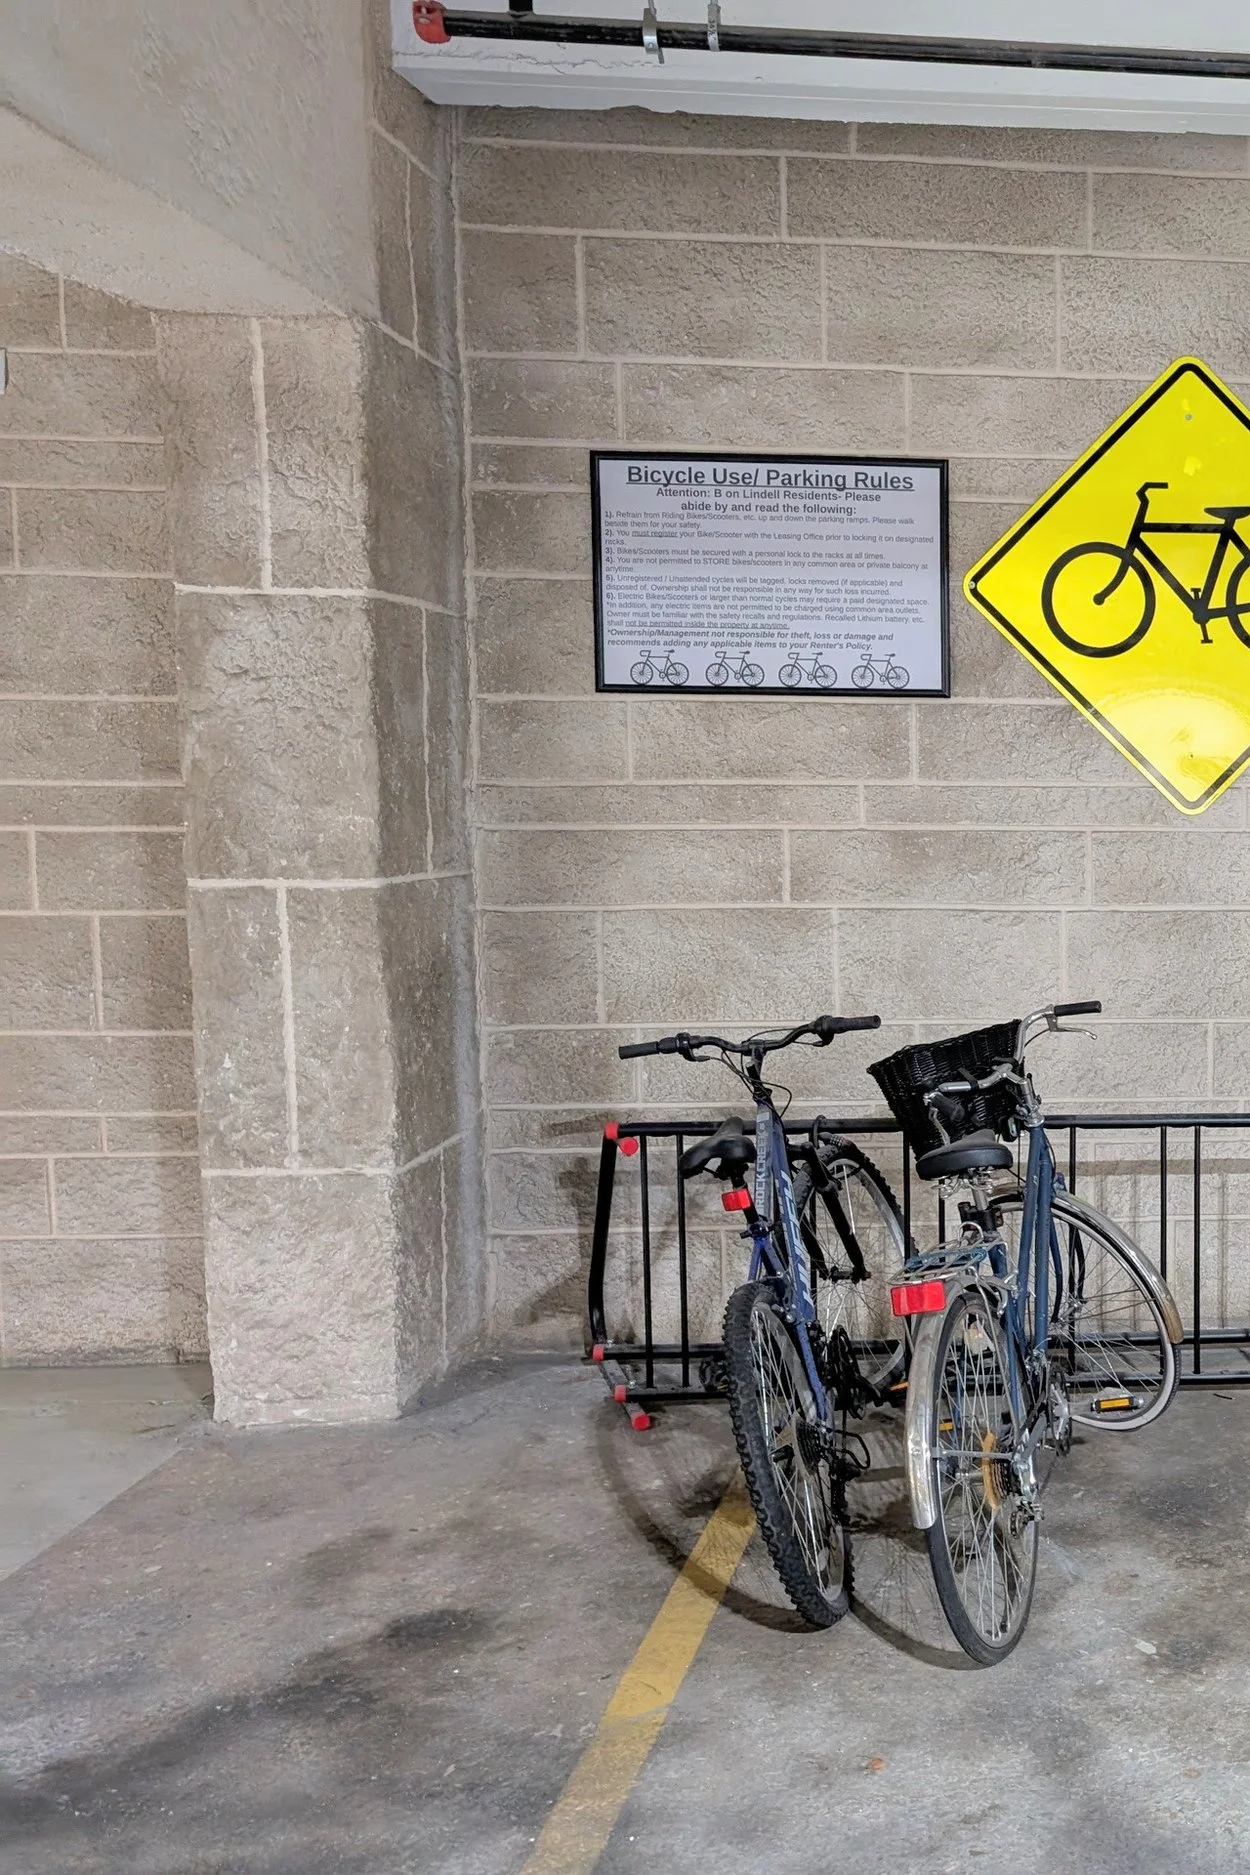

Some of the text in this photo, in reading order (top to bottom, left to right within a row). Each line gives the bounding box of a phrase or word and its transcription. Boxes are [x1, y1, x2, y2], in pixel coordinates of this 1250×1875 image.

[627, 466, 913, 490] Bicycle Use/ Parking Rules
[656, 487, 880, 501] Attention: B on Lindell Residents- Please
[680, 500, 856, 516] abide by and read the following:
[607, 638, 660, 646] recommends
[662, 639, 691, 648] adding
[709, 640, 752, 649] applicable
[726, 630, 775, 640] responsible
[843, 632, 876, 641] damage
[757, 1132, 767, 1172] CREEK
[757, 1172, 766, 1209] ROCK
